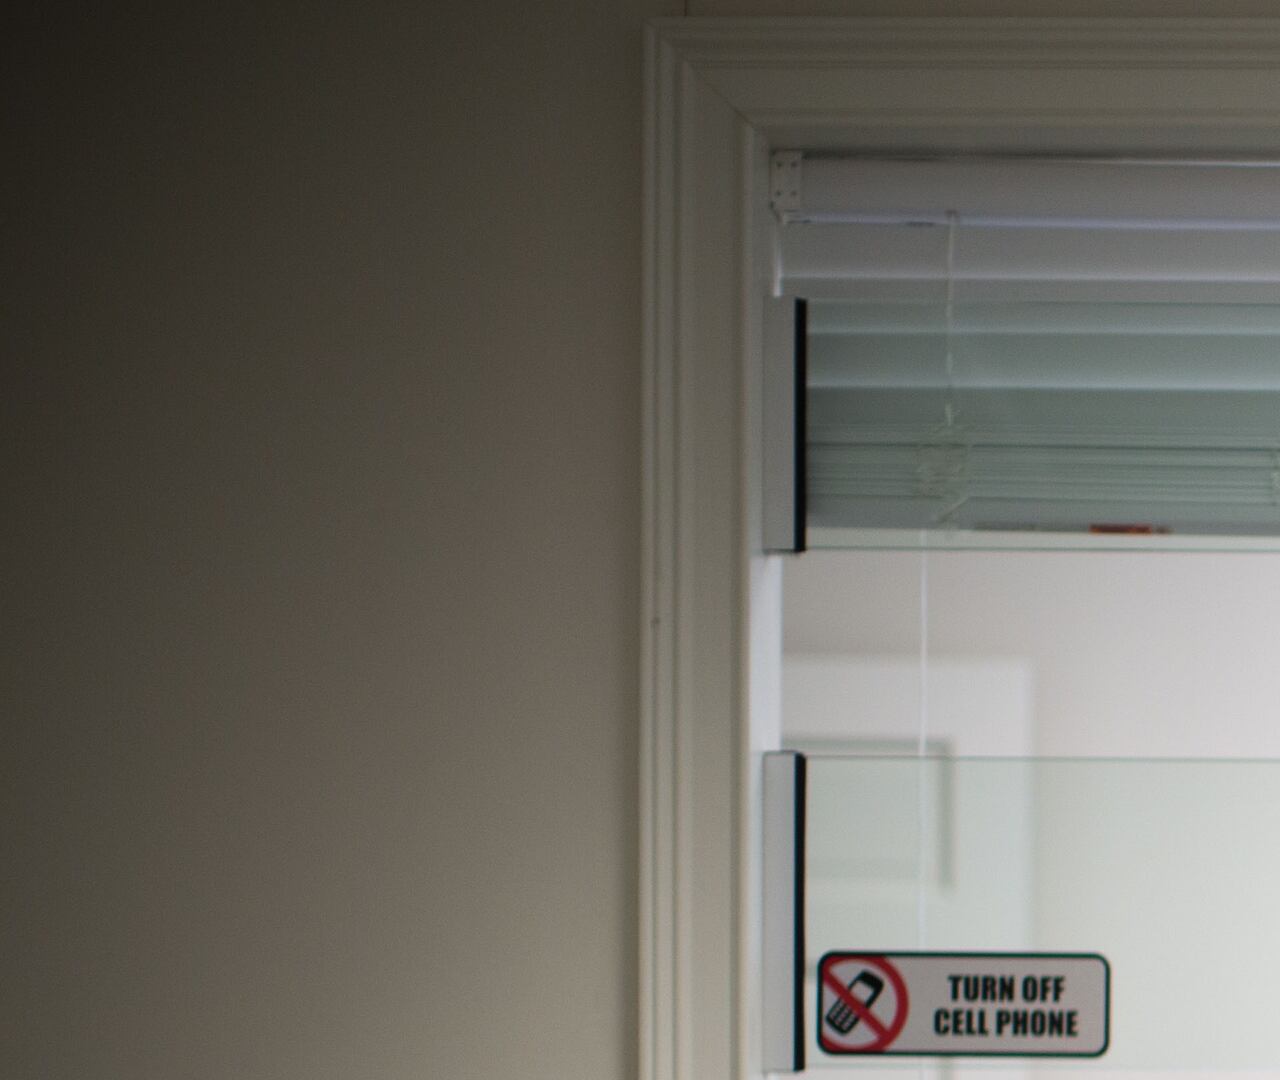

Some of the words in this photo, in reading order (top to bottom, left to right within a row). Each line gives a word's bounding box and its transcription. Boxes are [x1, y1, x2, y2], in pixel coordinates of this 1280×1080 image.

[948, 975, 1015, 1002] TURN
[1022, 976, 1066, 1003] OFF
[933, 1008, 988, 1036] CELL
[996, 1010, 1078, 1037] PHONE
